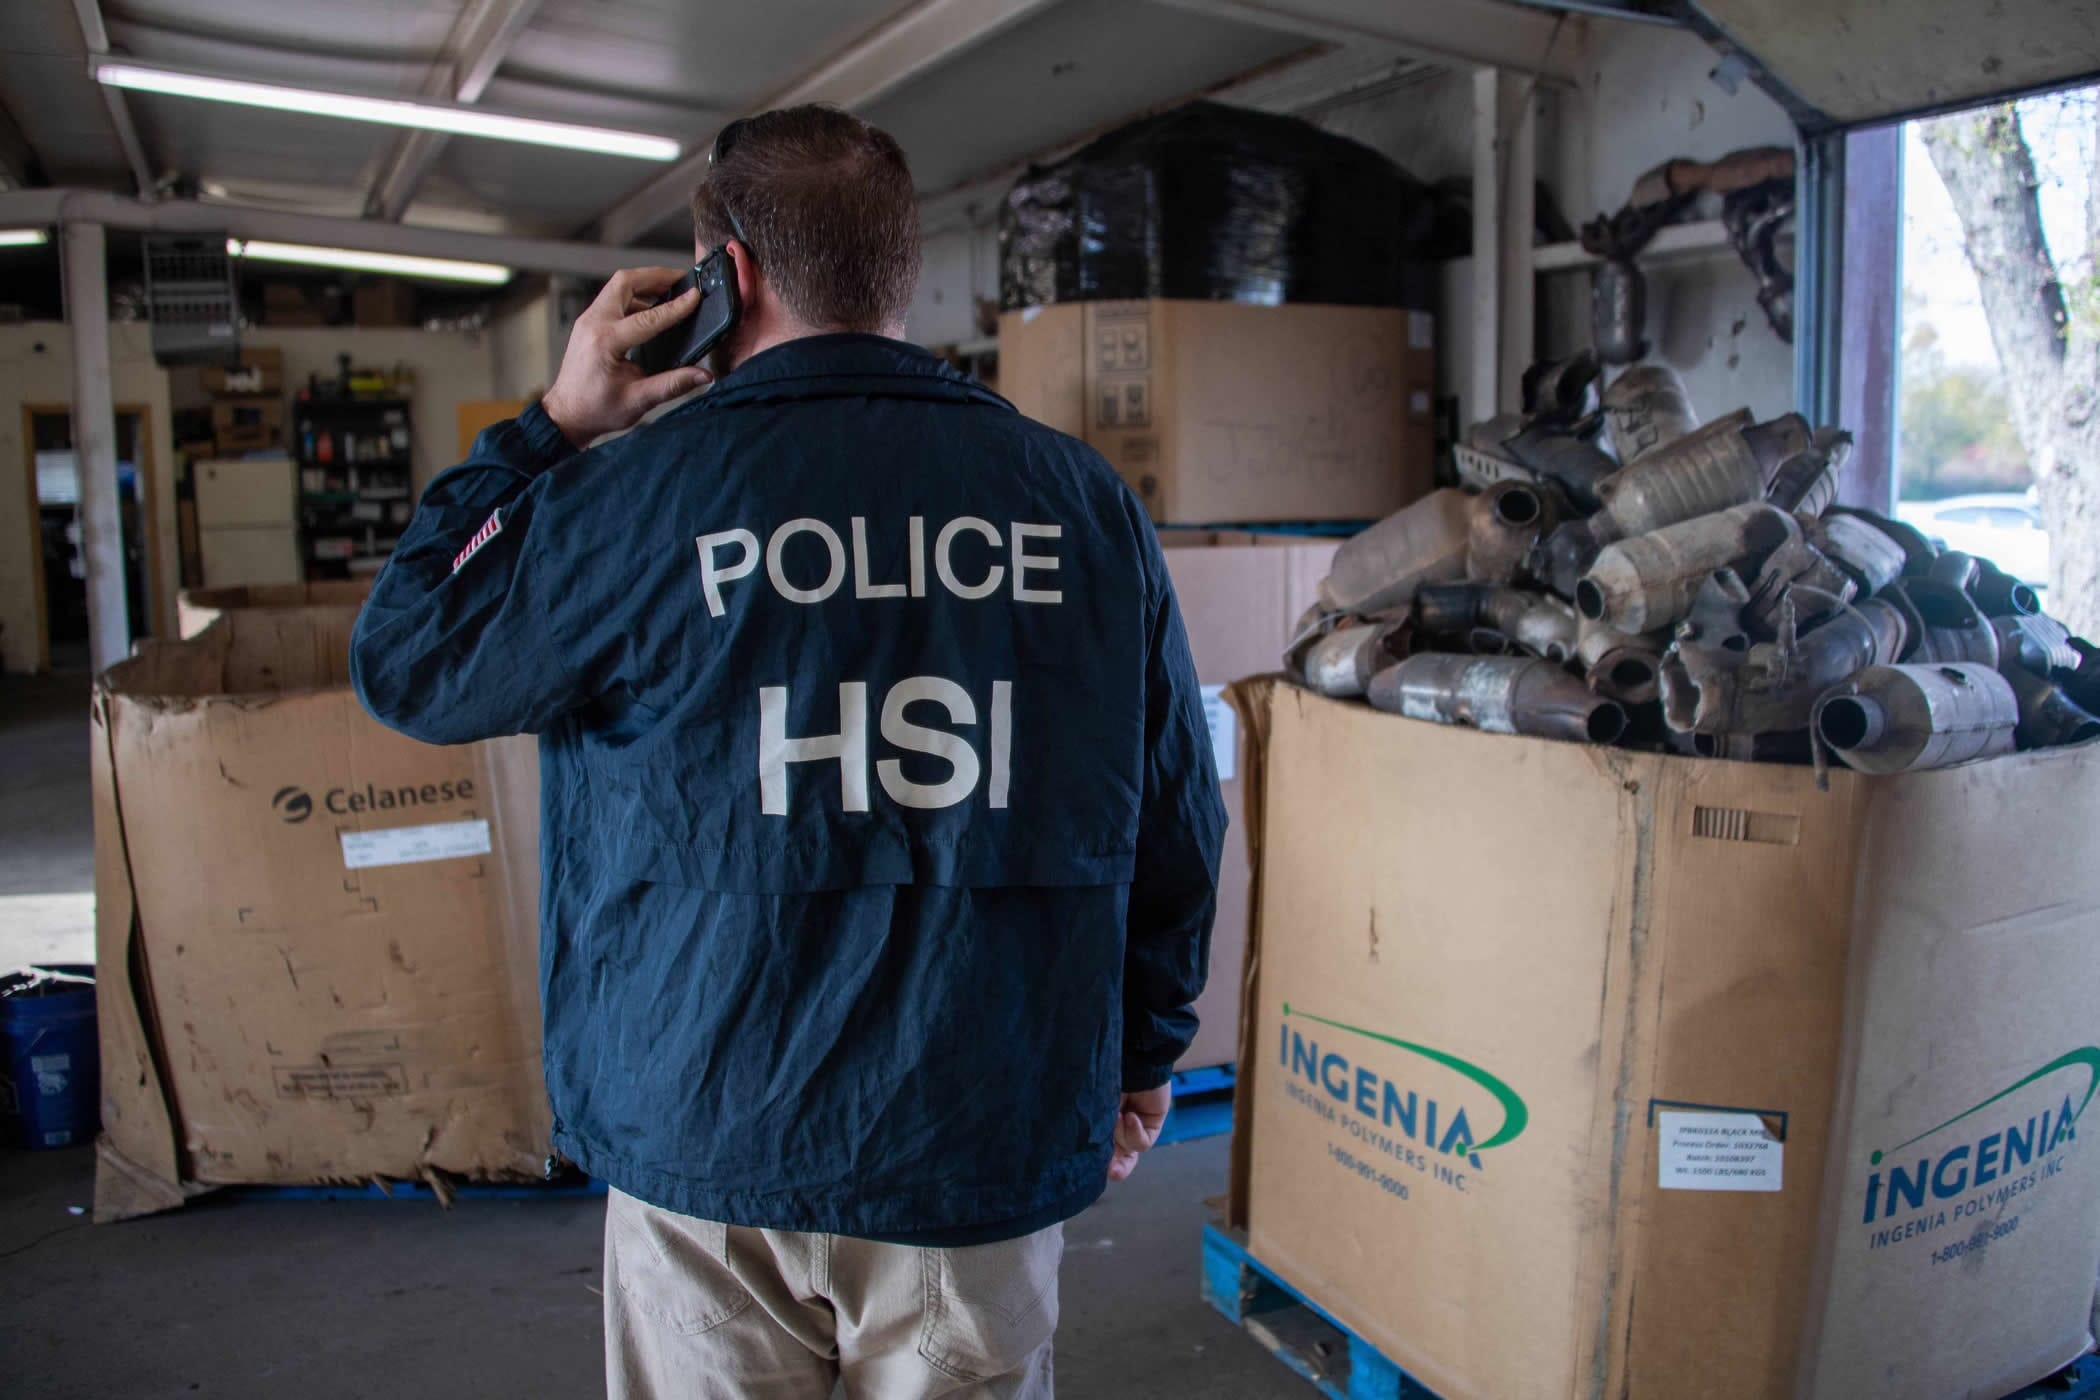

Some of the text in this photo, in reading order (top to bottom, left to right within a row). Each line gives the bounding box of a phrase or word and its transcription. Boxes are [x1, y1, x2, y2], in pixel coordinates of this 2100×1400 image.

[695, 515, 1063, 618] POLICE
[324, 778, 475, 815] Celanese
[759, 676, 1012, 816] HSI
[1280, 1023, 1483, 1171] INGENIA
[1285, 1081, 1336, 1122] INGENIA
[1341, 1114, 1427, 1172] POLYMERS
[1863, 1094, 2075, 1224] INGENIA
[1869, 1211, 1946, 1249] INGENIA
[1953, 1171, 2037, 1222] POLYMERS
